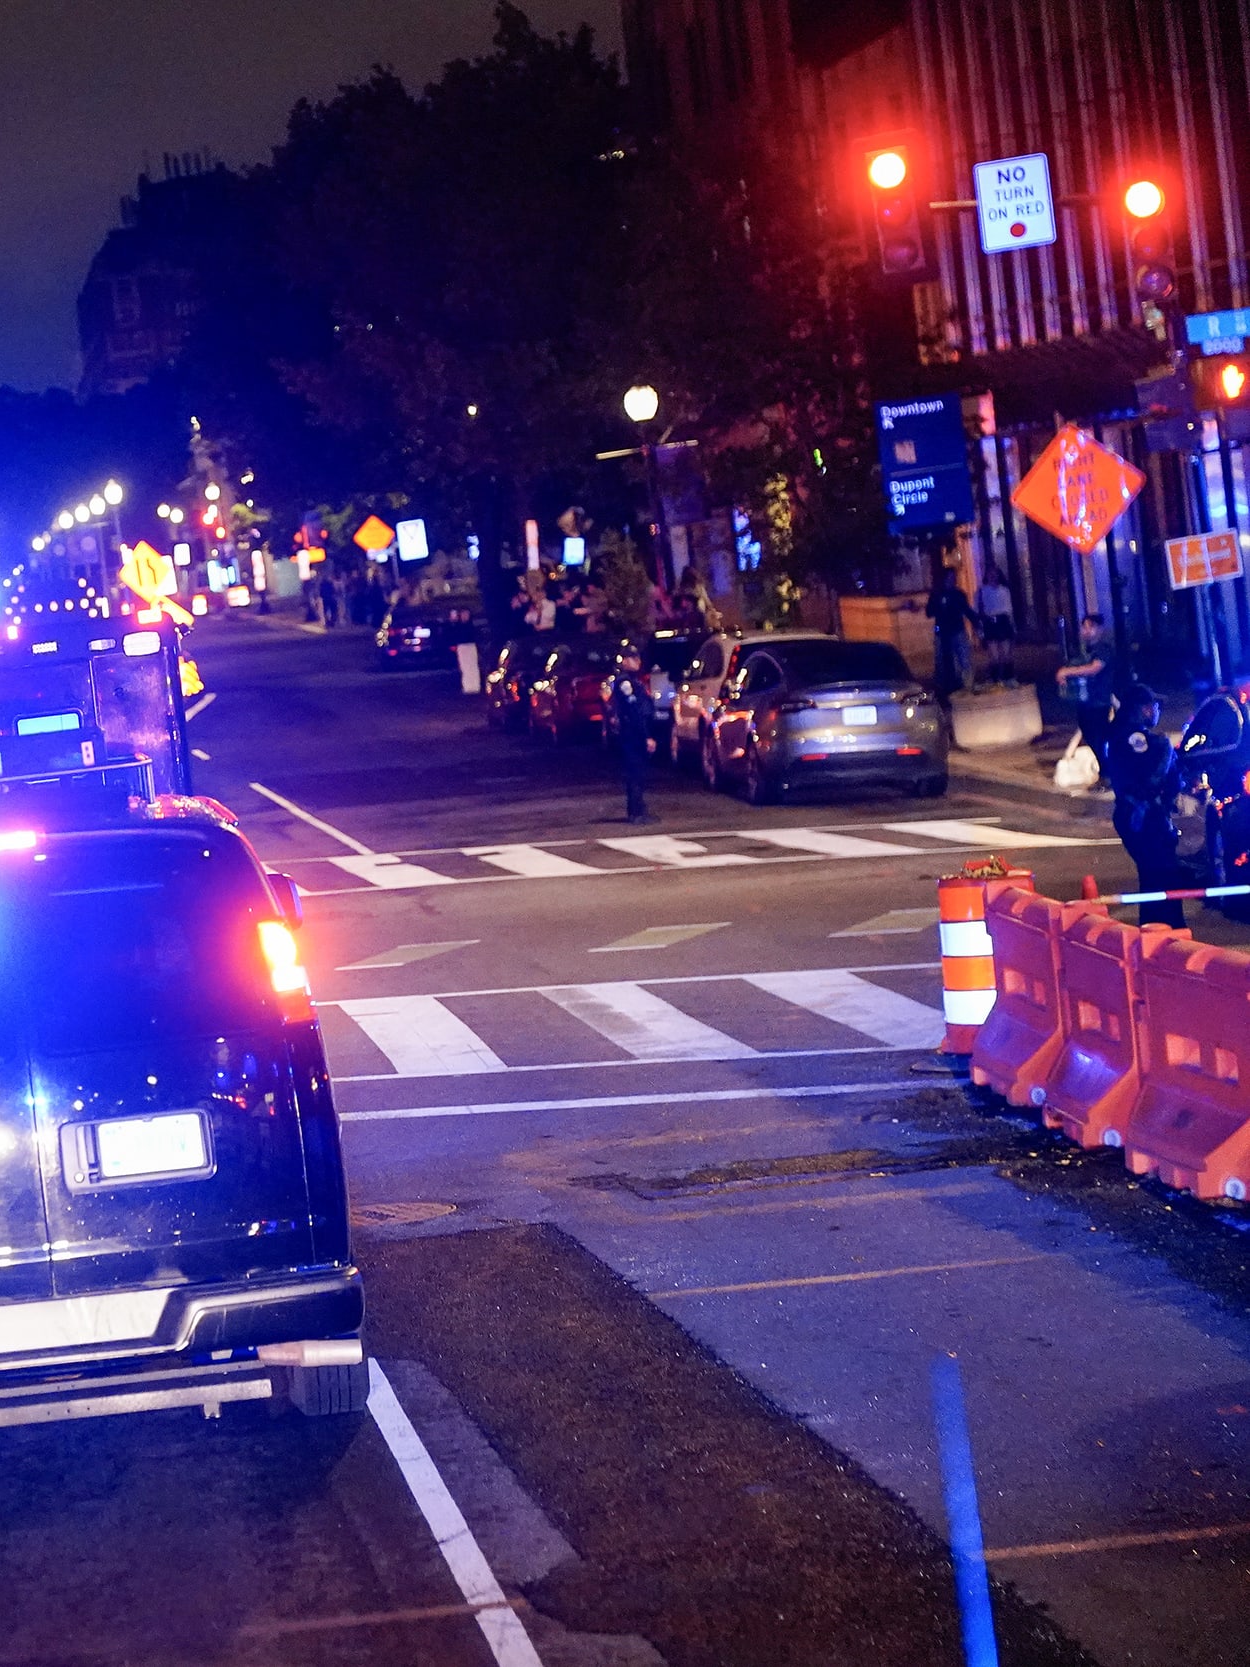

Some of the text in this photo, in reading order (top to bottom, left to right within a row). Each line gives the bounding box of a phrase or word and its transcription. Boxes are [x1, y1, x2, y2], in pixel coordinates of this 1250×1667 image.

[997, 166, 1026, 184] NO
[995, 185, 1034, 202] TURN
[988, 200, 1045, 222] ON RED
[880, 400, 944, 418] Downtown
[889, 476, 935, 494] Dupont
[891, 491, 929, 506] Circle
